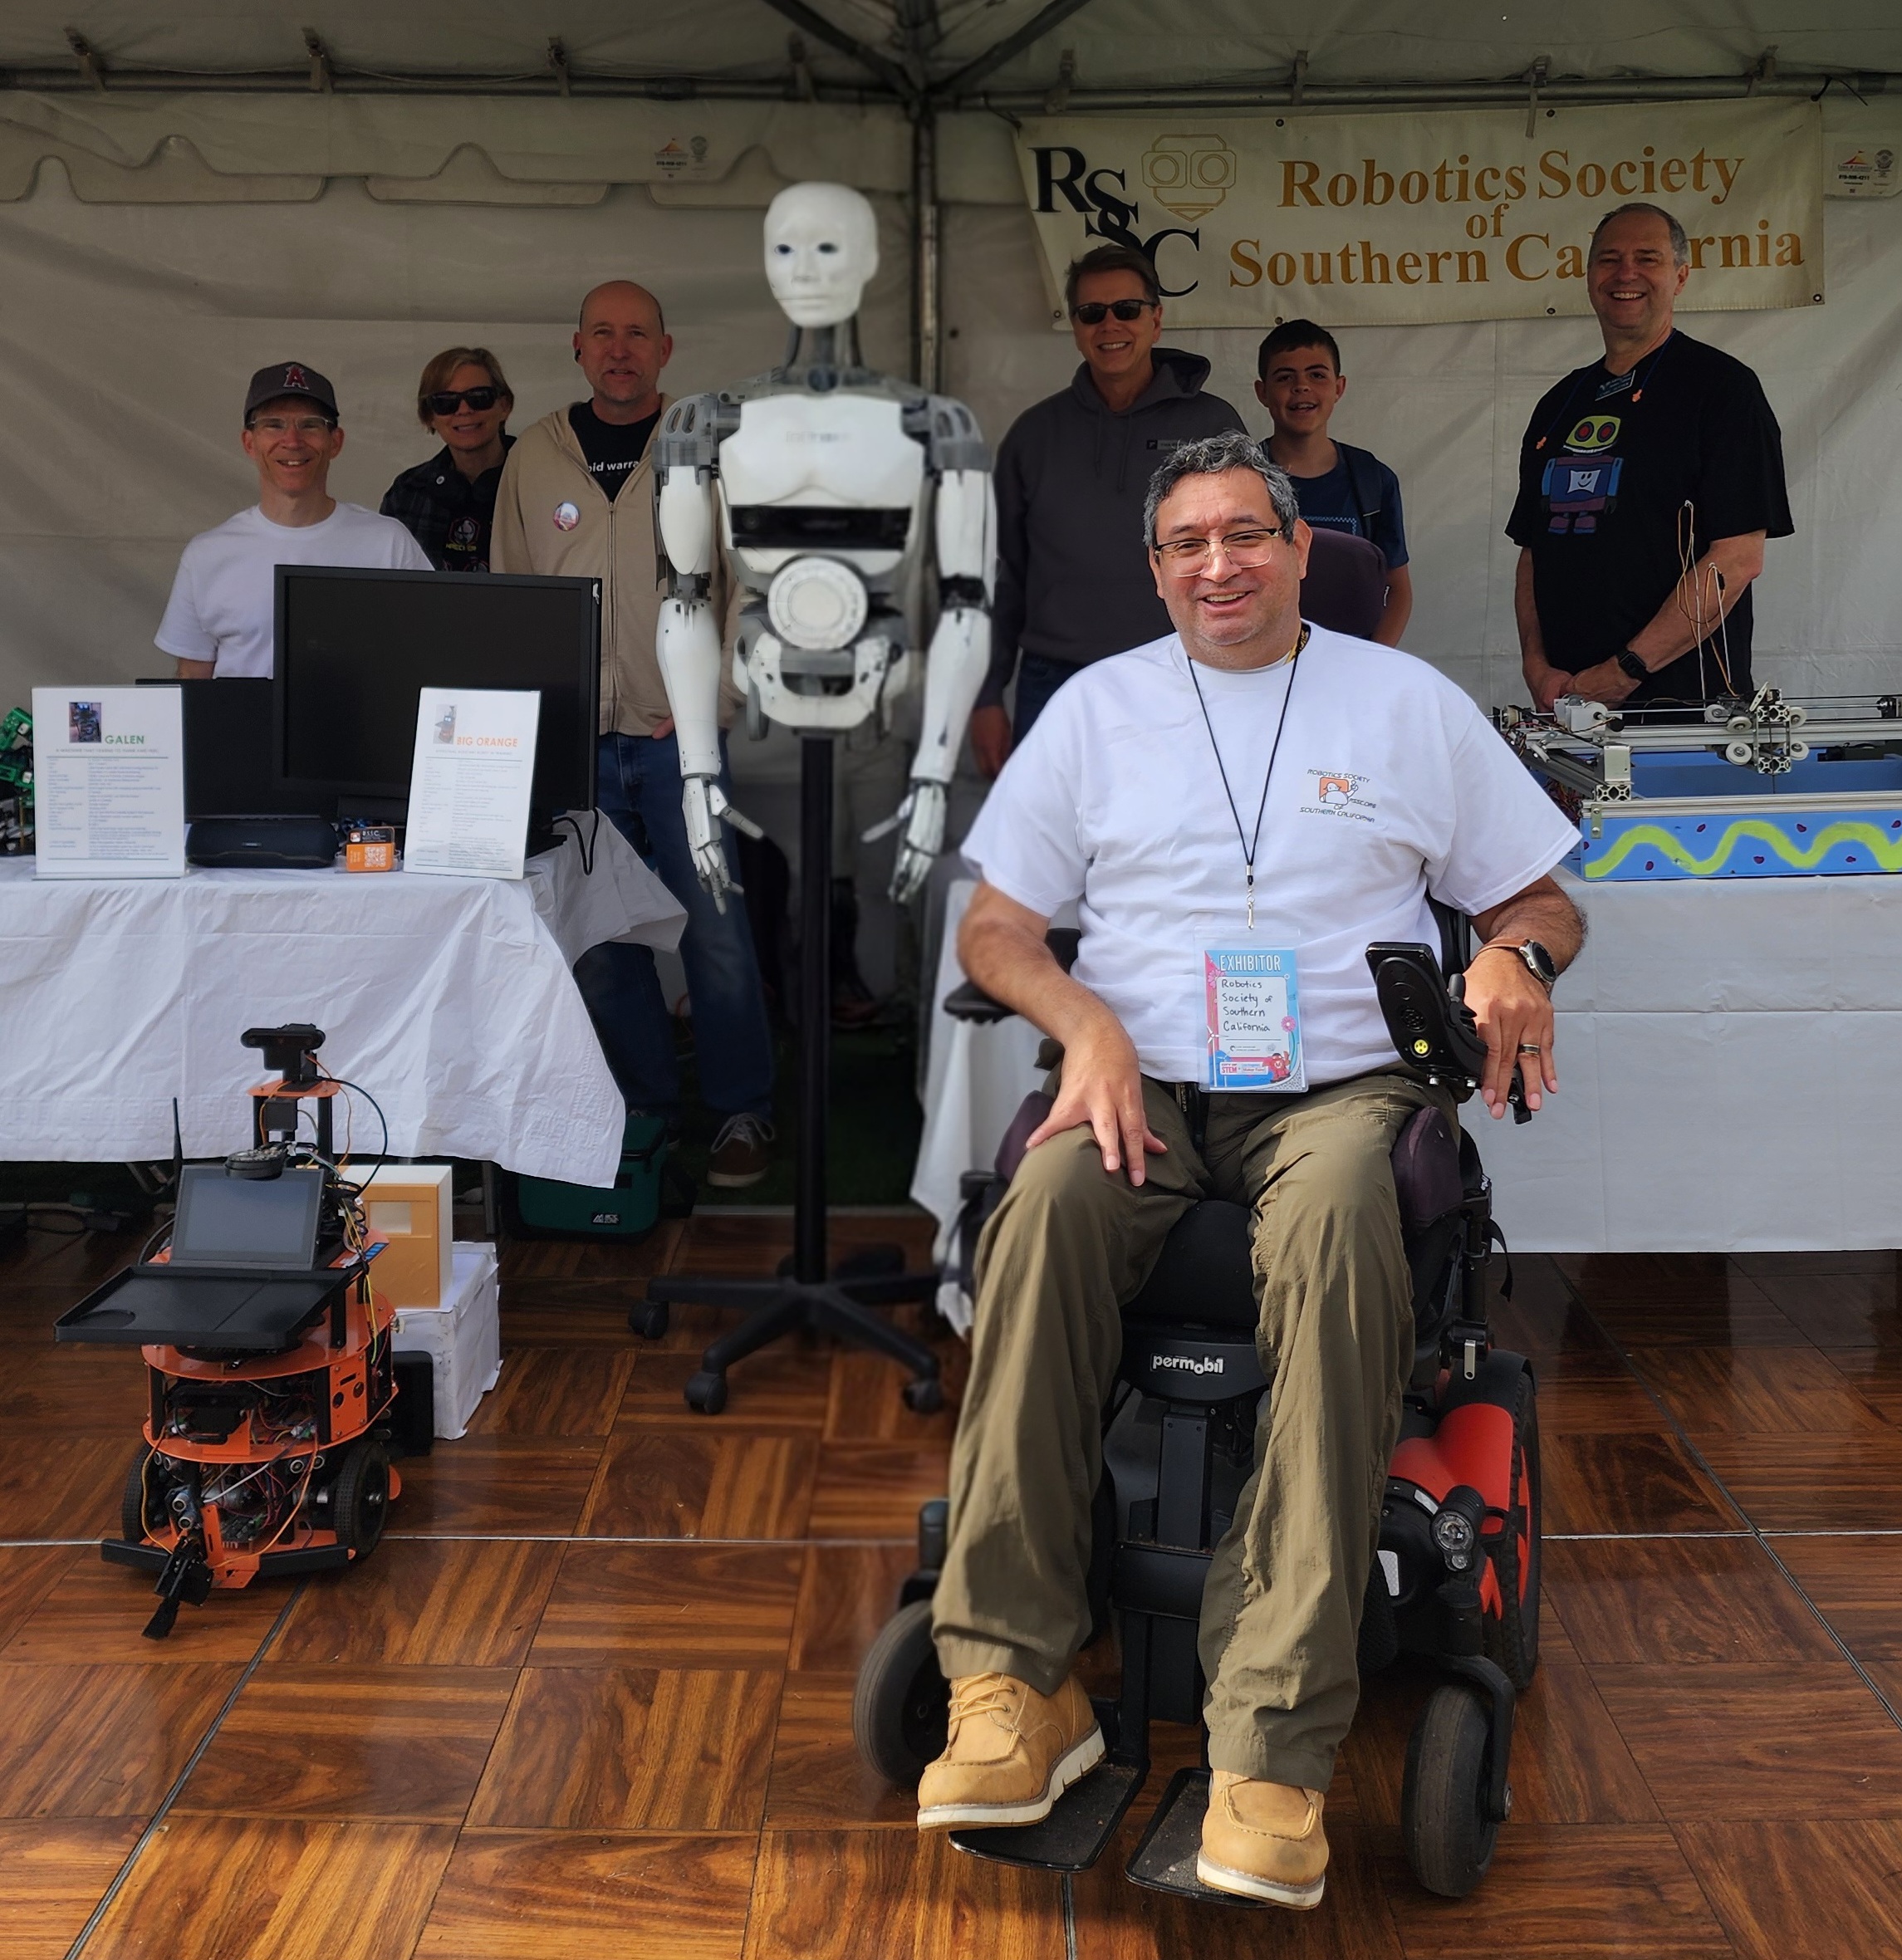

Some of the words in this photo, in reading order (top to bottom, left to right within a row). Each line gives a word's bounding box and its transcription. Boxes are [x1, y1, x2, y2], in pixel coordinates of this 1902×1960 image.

[1277, 154, 1527, 208] Robotics
[1538, 146, 1745, 204] Society
[1465, 203, 1510, 239] of
[1229, 238, 1490, 287] Southern
[1505, 219, 1806, 282] Carnia
[283, 365, 310, 390] A
[105, 735, 145, 745] GALEN
[456, 736, 473, 746] BIG
[476, 737, 518, 747] ORANGE
[1307, 769, 1342, 779] ROBOTICS
[1343, 773, 1370, 783] SOCIETY
[1300, 806, 1336, 816] SOUTHERN
[1337, 811, 1375, 823] CALIFORNIA
[1219, 954, 1282, 973] EXHIBITOR
[1221, 979, 1262, 989] Robotics
[1221, 992, 1259, 1008] Society
[1264, 995, 1273, 1003] of
[1223, 1006, 1266, 1018] Southern
[1223, 1021, 1271, 1032] California
[1152, 1355, 1224, 1374] permobil
